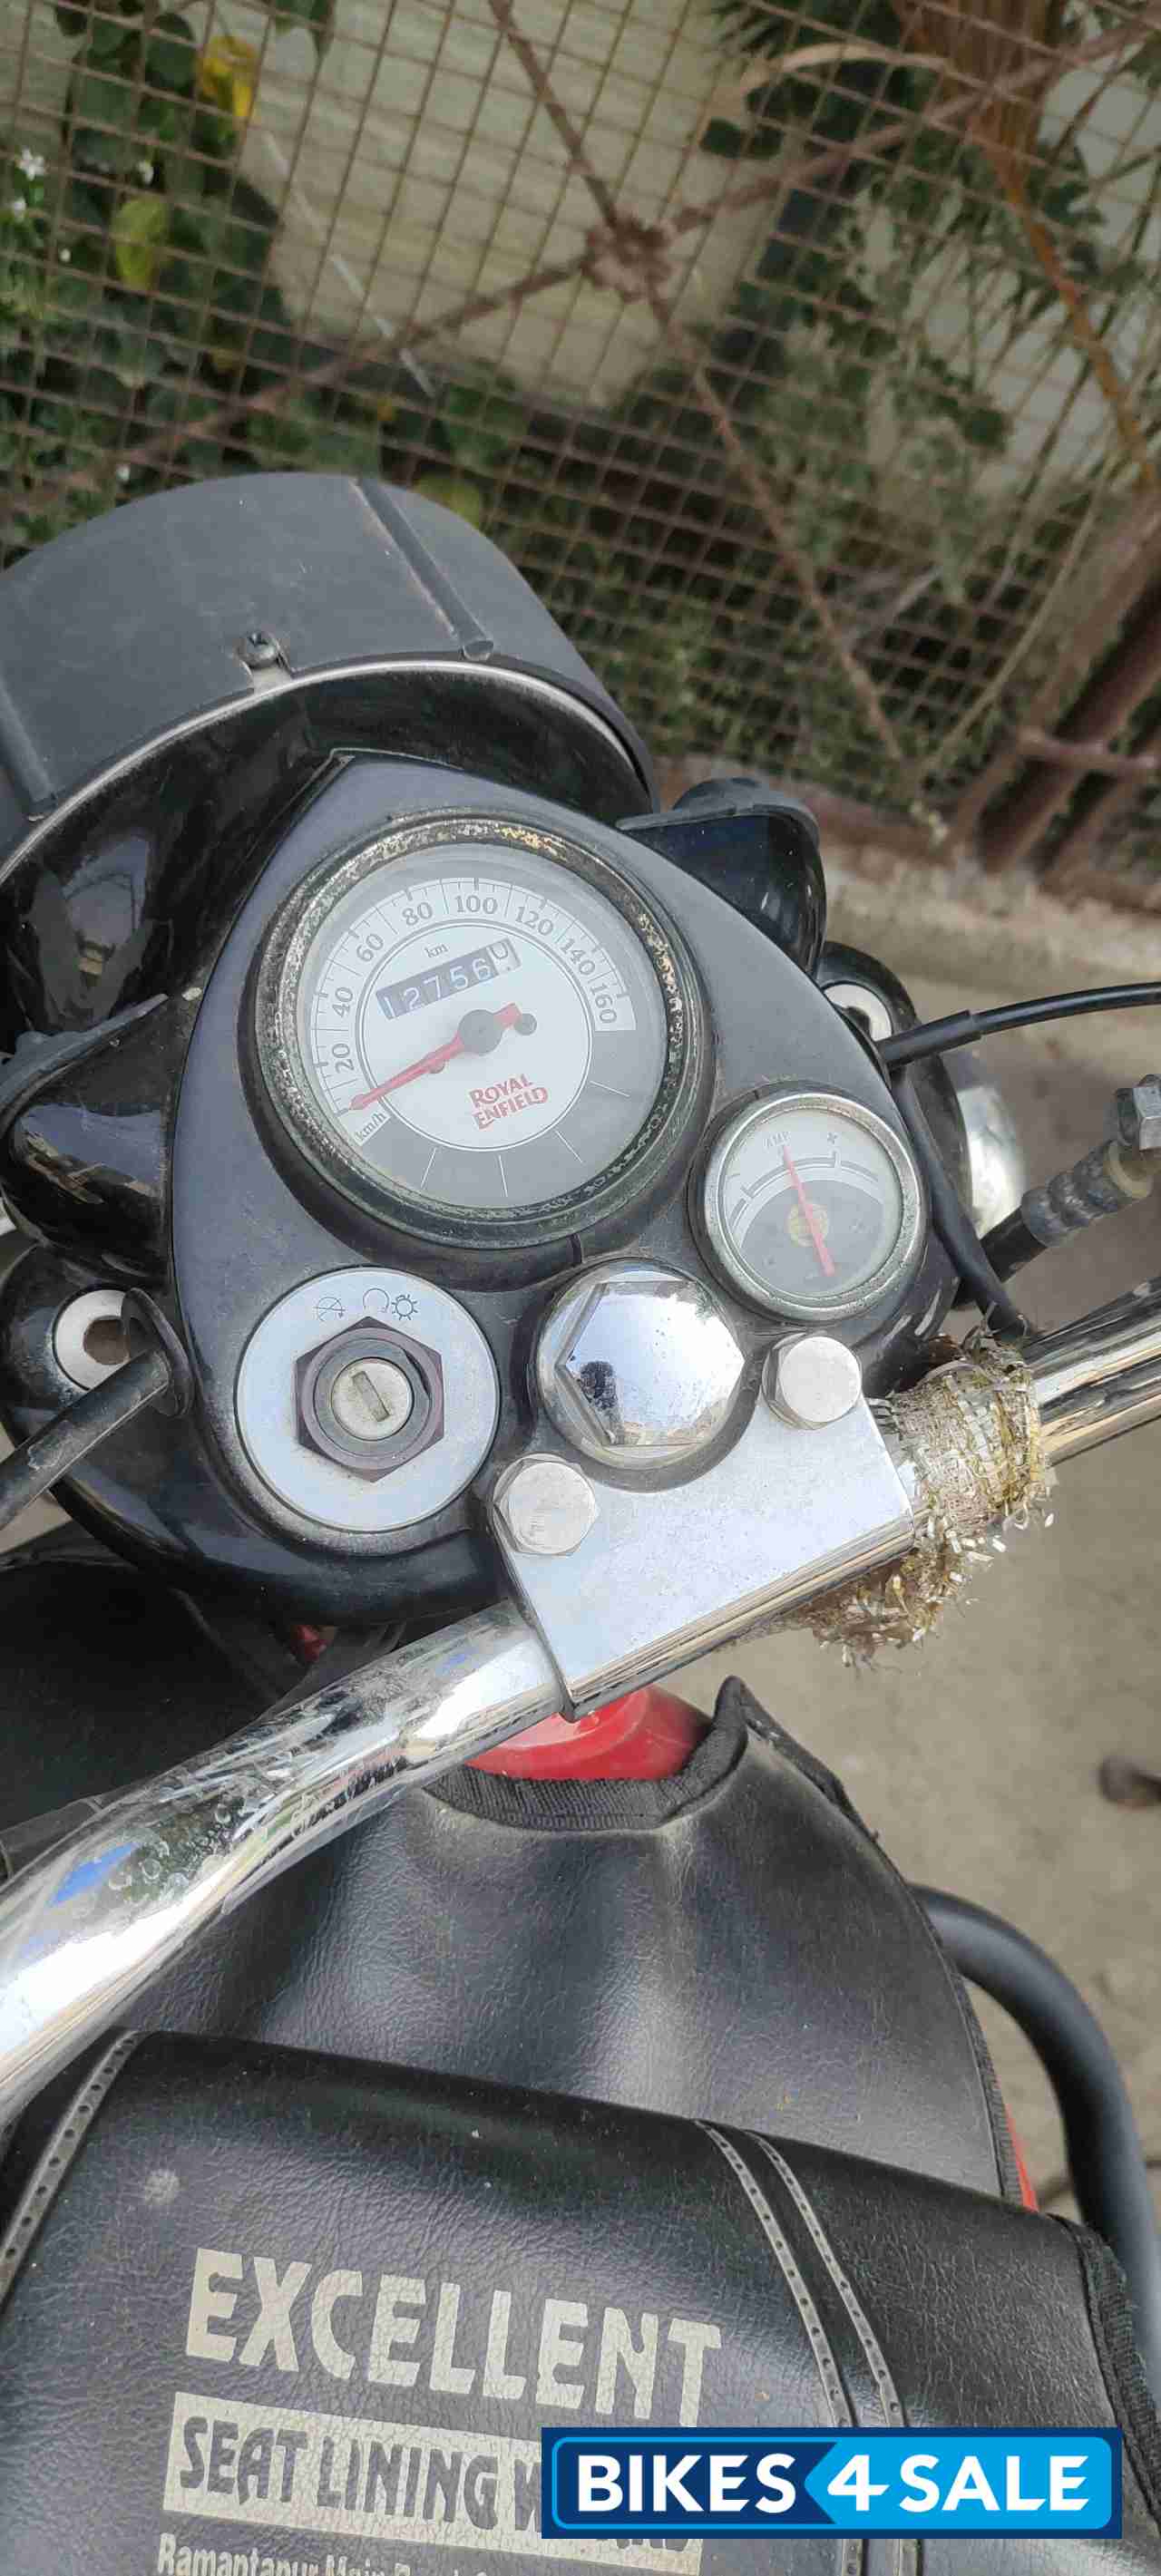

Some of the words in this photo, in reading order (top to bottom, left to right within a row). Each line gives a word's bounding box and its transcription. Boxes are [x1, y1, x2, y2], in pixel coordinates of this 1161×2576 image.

[401, 902, 434, 927] 80
[454, 895, 499, 915] 100
[515, 907, 553, 936] 120
[356, 933, 385, 961] 60
[424, 943, 448, 958] km
[561, 938, 595, 975] 140
[332, 987, 354, 1017] 40
[590, 983, 617, 1023] 160
[332, 1043, 355, 1074] 20
[469, 1074, 533, 1108] ROYAL
[473, 1087, 549, 1130] ENFIELD
[355, 1111, 386, 1142] km/h
[185, 2248, 722, 2427] EXCELLENT
[180, 2416, 307, 2505] SEAT
[317, 2435, 499, 2530] LINING
